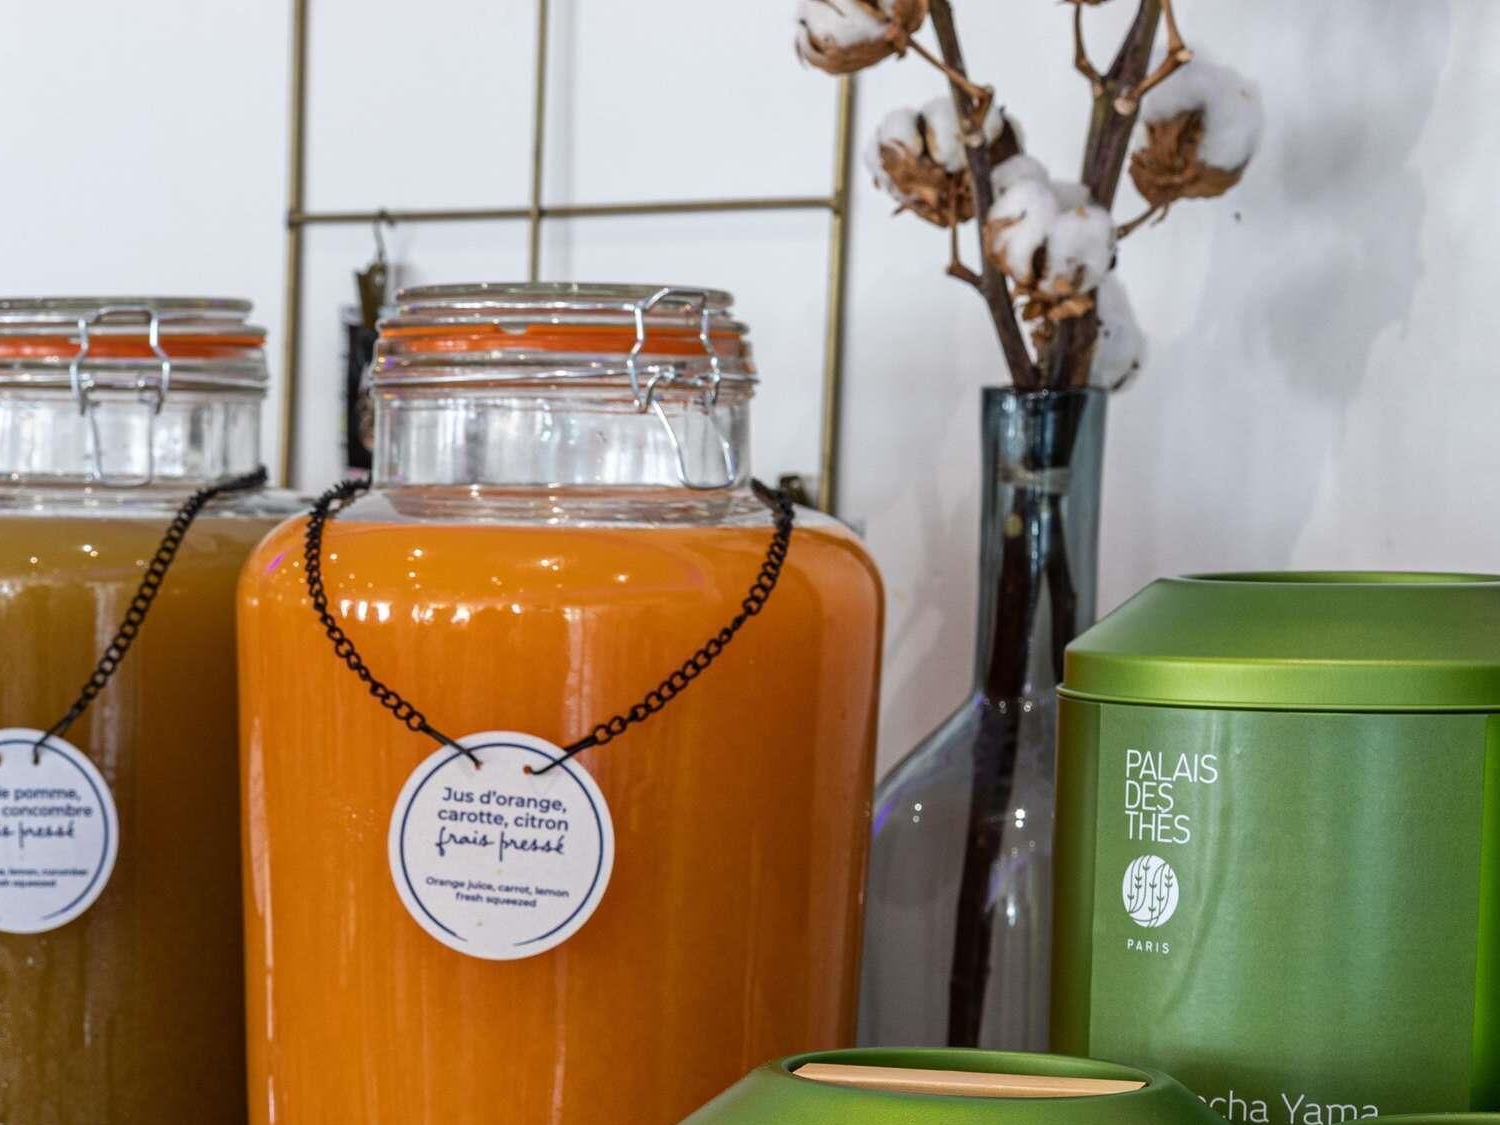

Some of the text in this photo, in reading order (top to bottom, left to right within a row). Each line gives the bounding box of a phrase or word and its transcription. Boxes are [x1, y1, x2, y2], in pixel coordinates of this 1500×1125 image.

[1125, 749, 1219, 784] PALAIS
[13, 788, 81, 802] pomme,
[442, 786, 567, 814] Jus d'orange,
[1124, 780, 1174, 811] DES
[1, 803, 93, 818] concombre
[437, 808, 569, 832] carotte, citron
[1124, 803, 1191, 844] THÉS
[18, 820, 76, 849] pressé
[434, 825, 566, 862] frais pressé
[425, 876, 570, 898] Orange juice, carrot, lemon
[455, 891, 537, 908] fresh squeezed
[1126, 938, 1170, 954] PARIS
[1281, 1092, 1379, 1125] Yama
